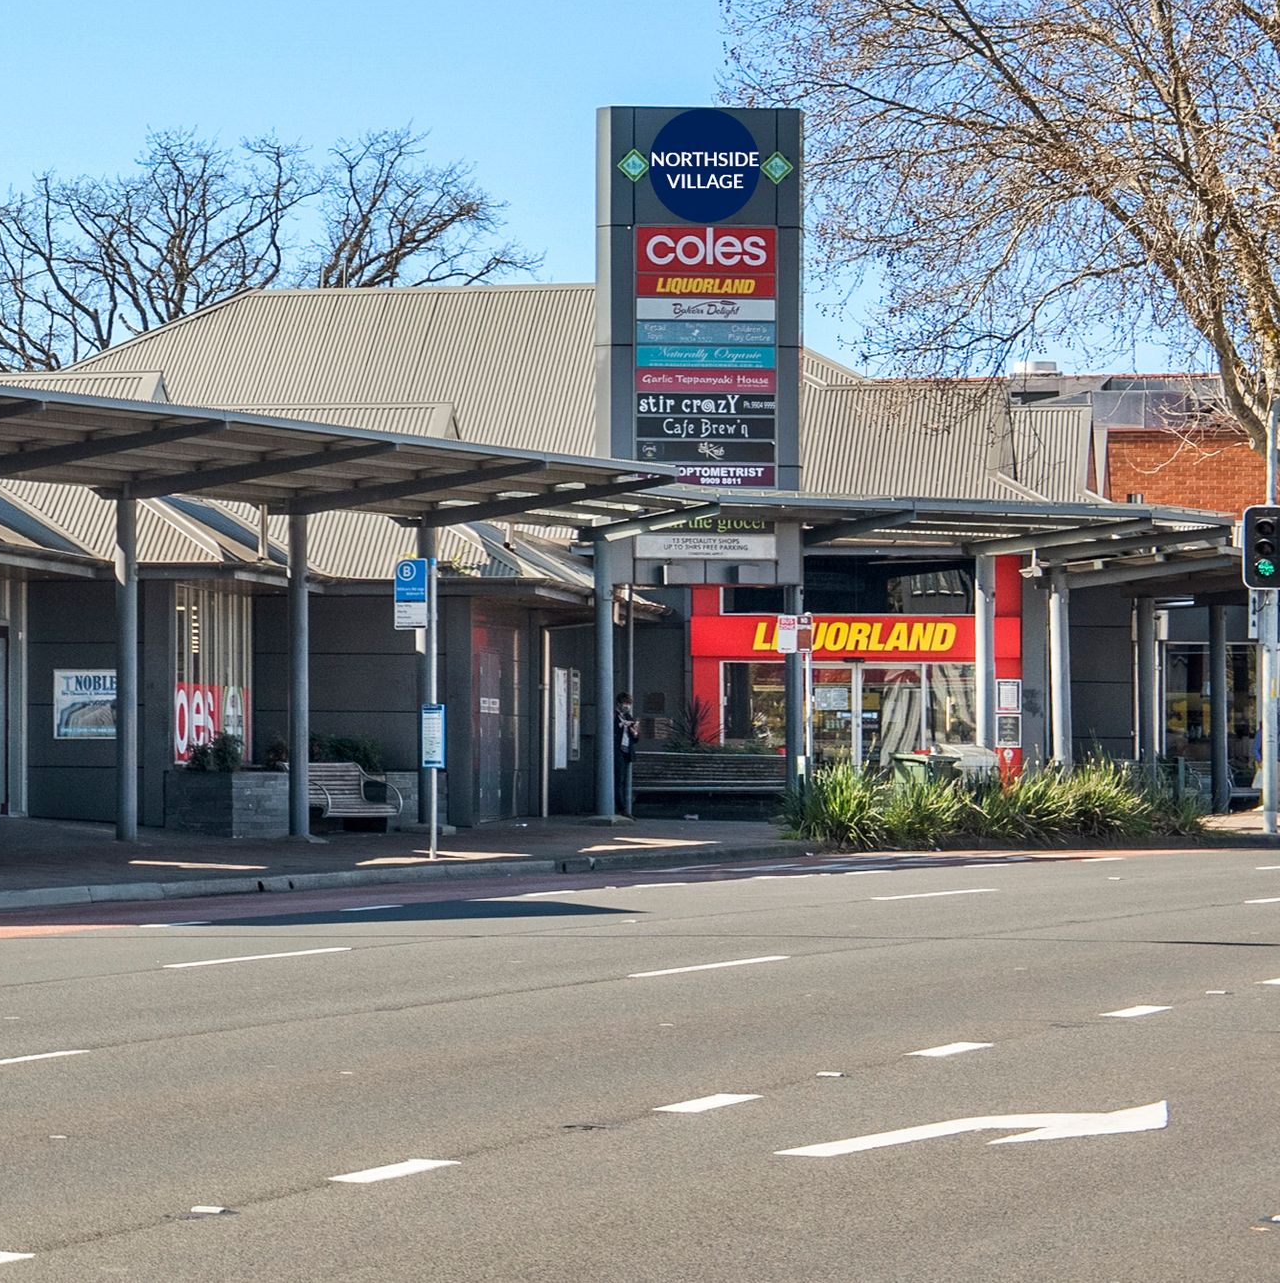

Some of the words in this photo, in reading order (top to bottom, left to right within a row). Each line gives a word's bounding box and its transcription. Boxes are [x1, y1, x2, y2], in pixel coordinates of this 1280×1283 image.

[651, 151, 759, 167] NORTHSIDE
[666, 173, 744, 189] VILLAGE
[646, 227, 767, 266] coles
[656, 278, 756, 295] LIQUORLAND
[707, 303, 740, 318] Delight
[658, 347, 708, 362] Naturally
[714, 347, 761, 362] Organic
[642, 374, 673, 384] Garlic
[675, 374, 733, 385] Teppanyaki
[737, 375, 769, 384] House
[639, 395, 675, 413] stir
[663, 418, 694, 438] Cafe
[679, 467, 764, 477] OPTOMETRIST
[403, 566, 411, 577] B
[752, 622, 957, 651] LIUORLAND
